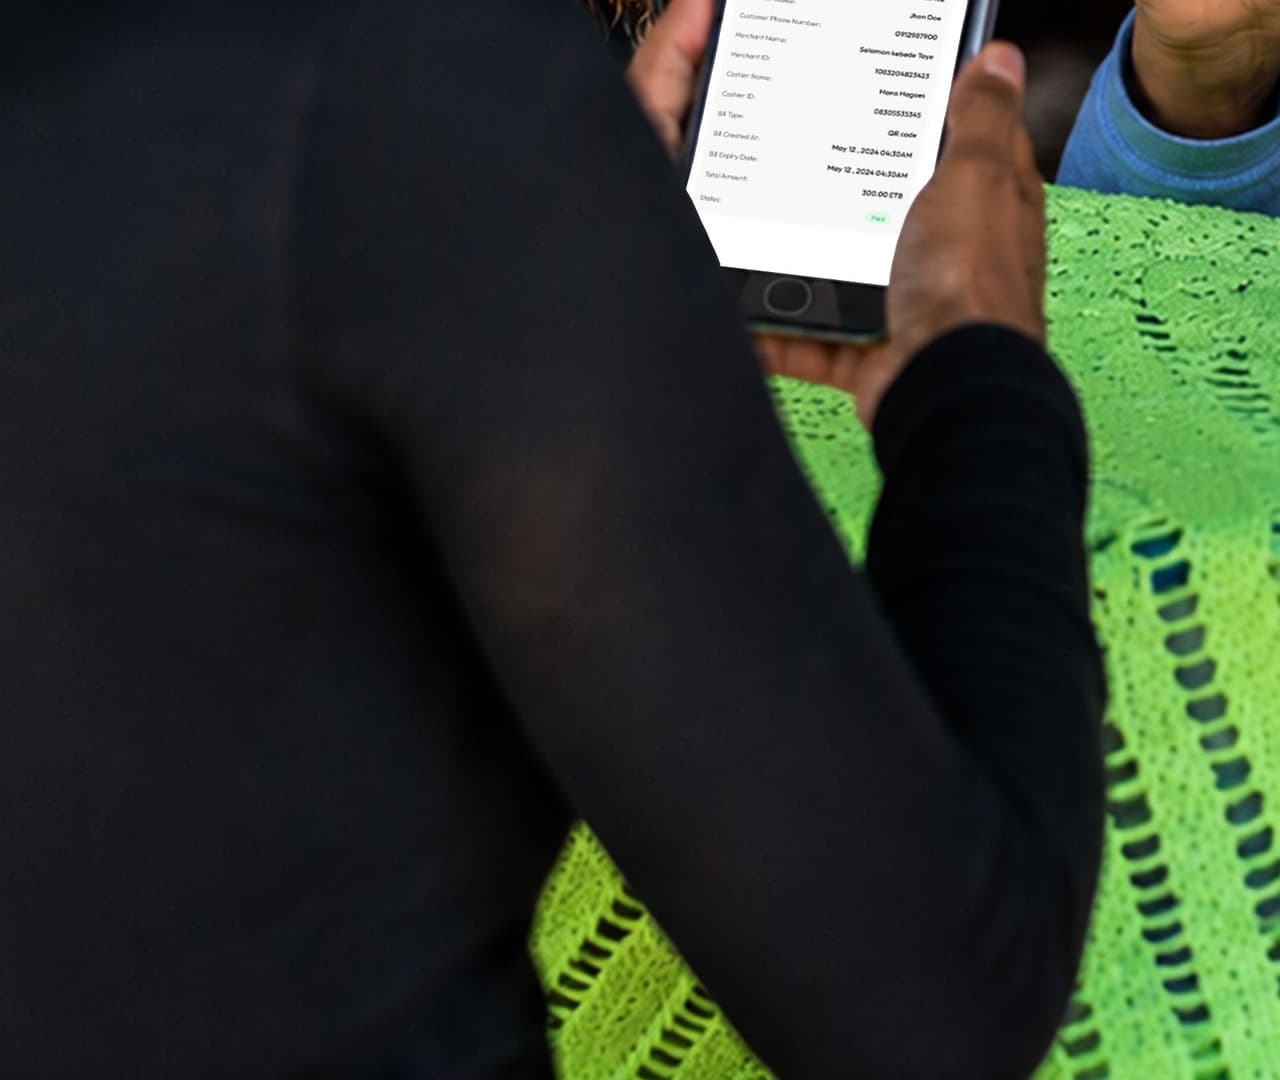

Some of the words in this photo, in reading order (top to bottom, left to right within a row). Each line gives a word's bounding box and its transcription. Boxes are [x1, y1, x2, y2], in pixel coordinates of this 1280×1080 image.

[739, 12, 769, 20] Customer
[769, 15, 791, 23] Phone
[735, 31, 764, 40] Merchant
[859, 46, 890, 55] Solomon
[731, 51, 760, 60] Merchant
[726, 70, 749, 78] Cashier
[721, 90, 745, 98] Cashier
[722, 131, 749, 140] Created
[831, 144, 848, 153] May
[860, 147, 879, 156] 2024
[718, 152, 739, 161] Expiry
[705, 170, 721, 179] Total
[826, 164, 843, 173] May
[855, 167, 874, 176] 2024
[861, 189, 888, 198] 300.00
[888, 191, 904, 200] ETB
